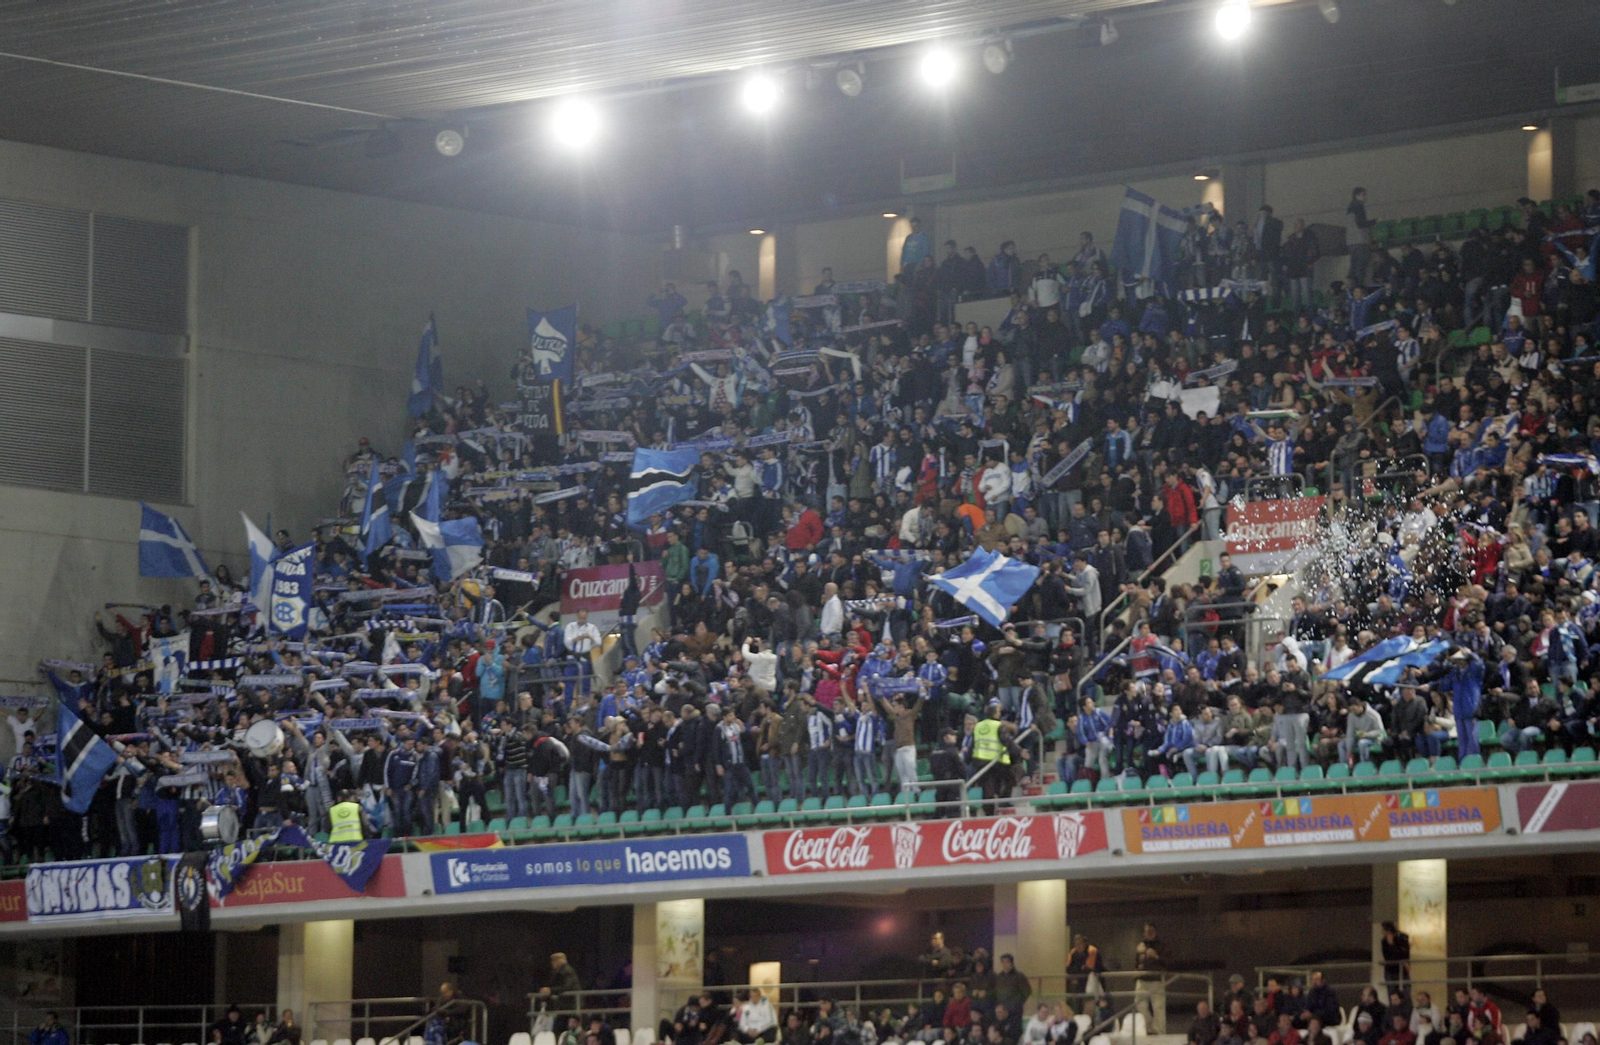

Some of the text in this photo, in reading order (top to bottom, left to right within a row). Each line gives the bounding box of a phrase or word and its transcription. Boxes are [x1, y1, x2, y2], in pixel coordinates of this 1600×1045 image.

[1263, 812, 1354, 832] SANSUEÑA
[1388, 804, 1483, 825] SANSUEÑA
[942, 817, 1033, 862] Coca-Cola
[1141, 820, 1231, 840] SANSUEÑA
[525, 846, 732, 874] somos lo que hacemos
[783, 826, 873, 871] Coca-Cola
[234, 871, 304, 901] CajaSur
[0, 895, 21, 912] ur
